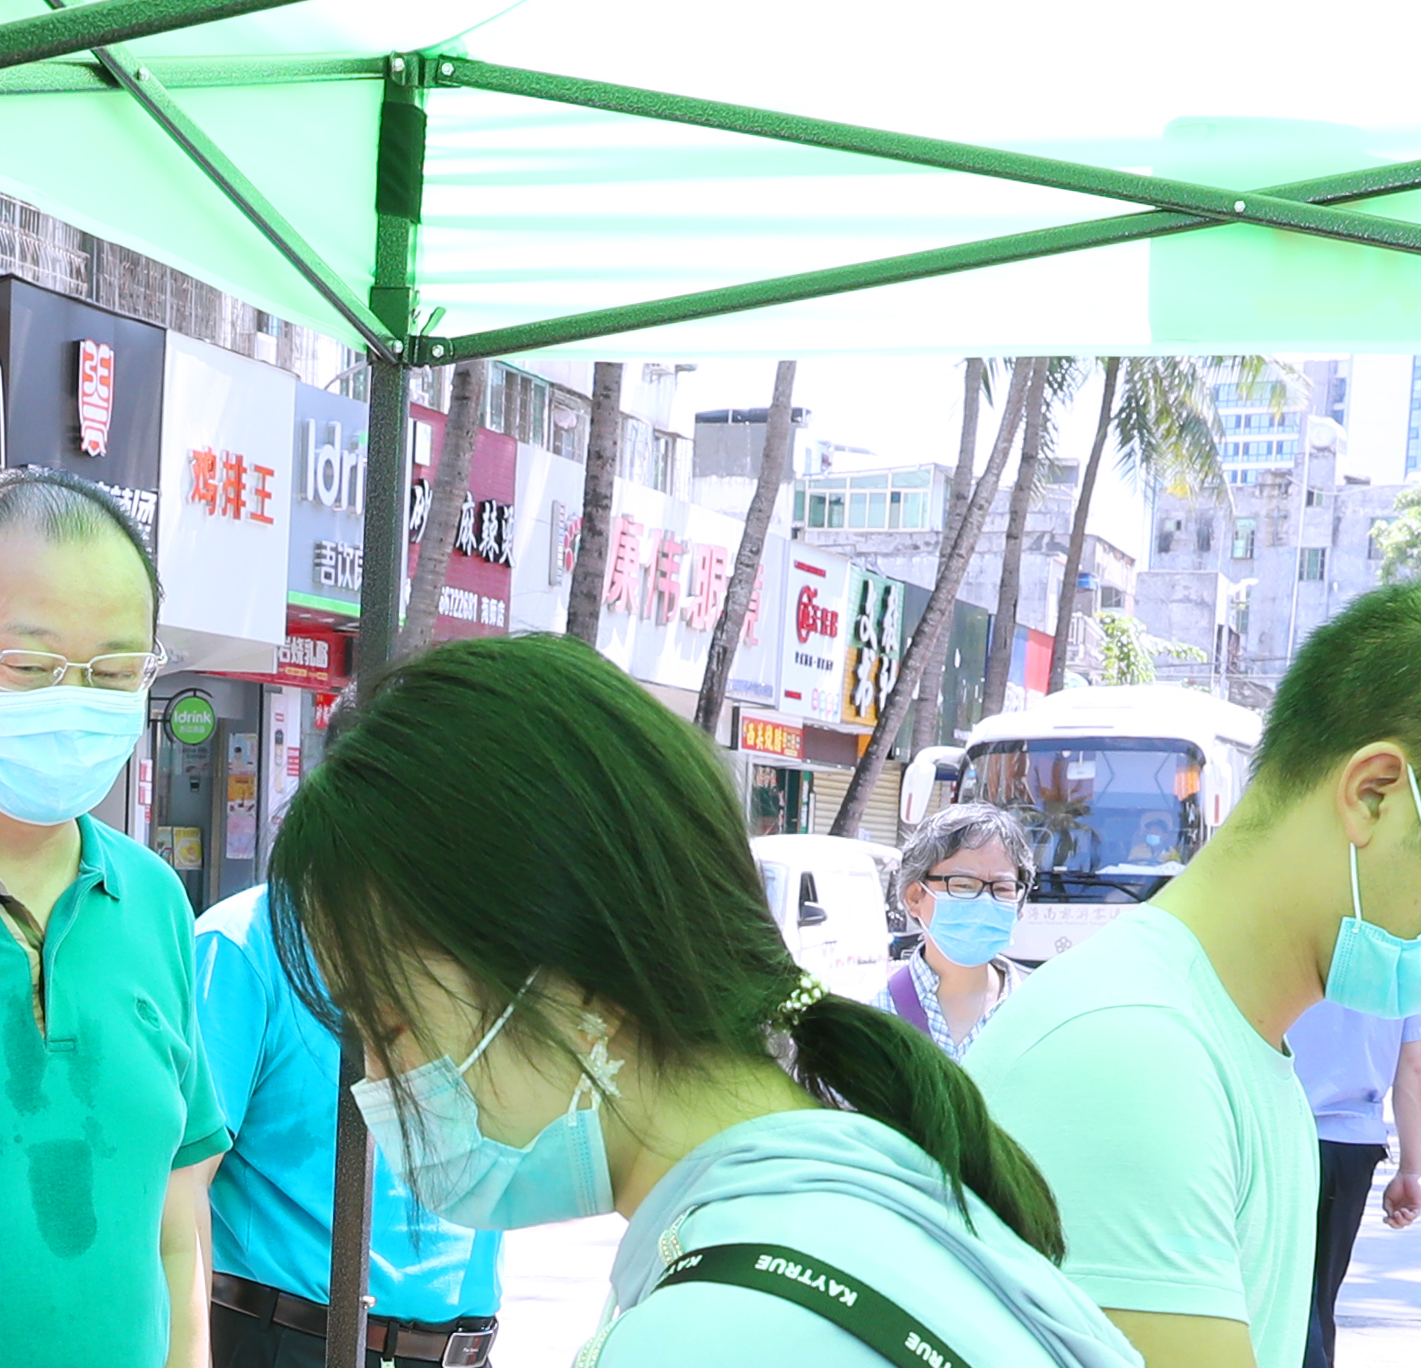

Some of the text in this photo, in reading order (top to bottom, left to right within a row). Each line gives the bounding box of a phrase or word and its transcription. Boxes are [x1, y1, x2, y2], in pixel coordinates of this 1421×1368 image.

[190, 446, 275, 526] 鸡排王
[754, 1254, 858, 1307] KAYTRUE
